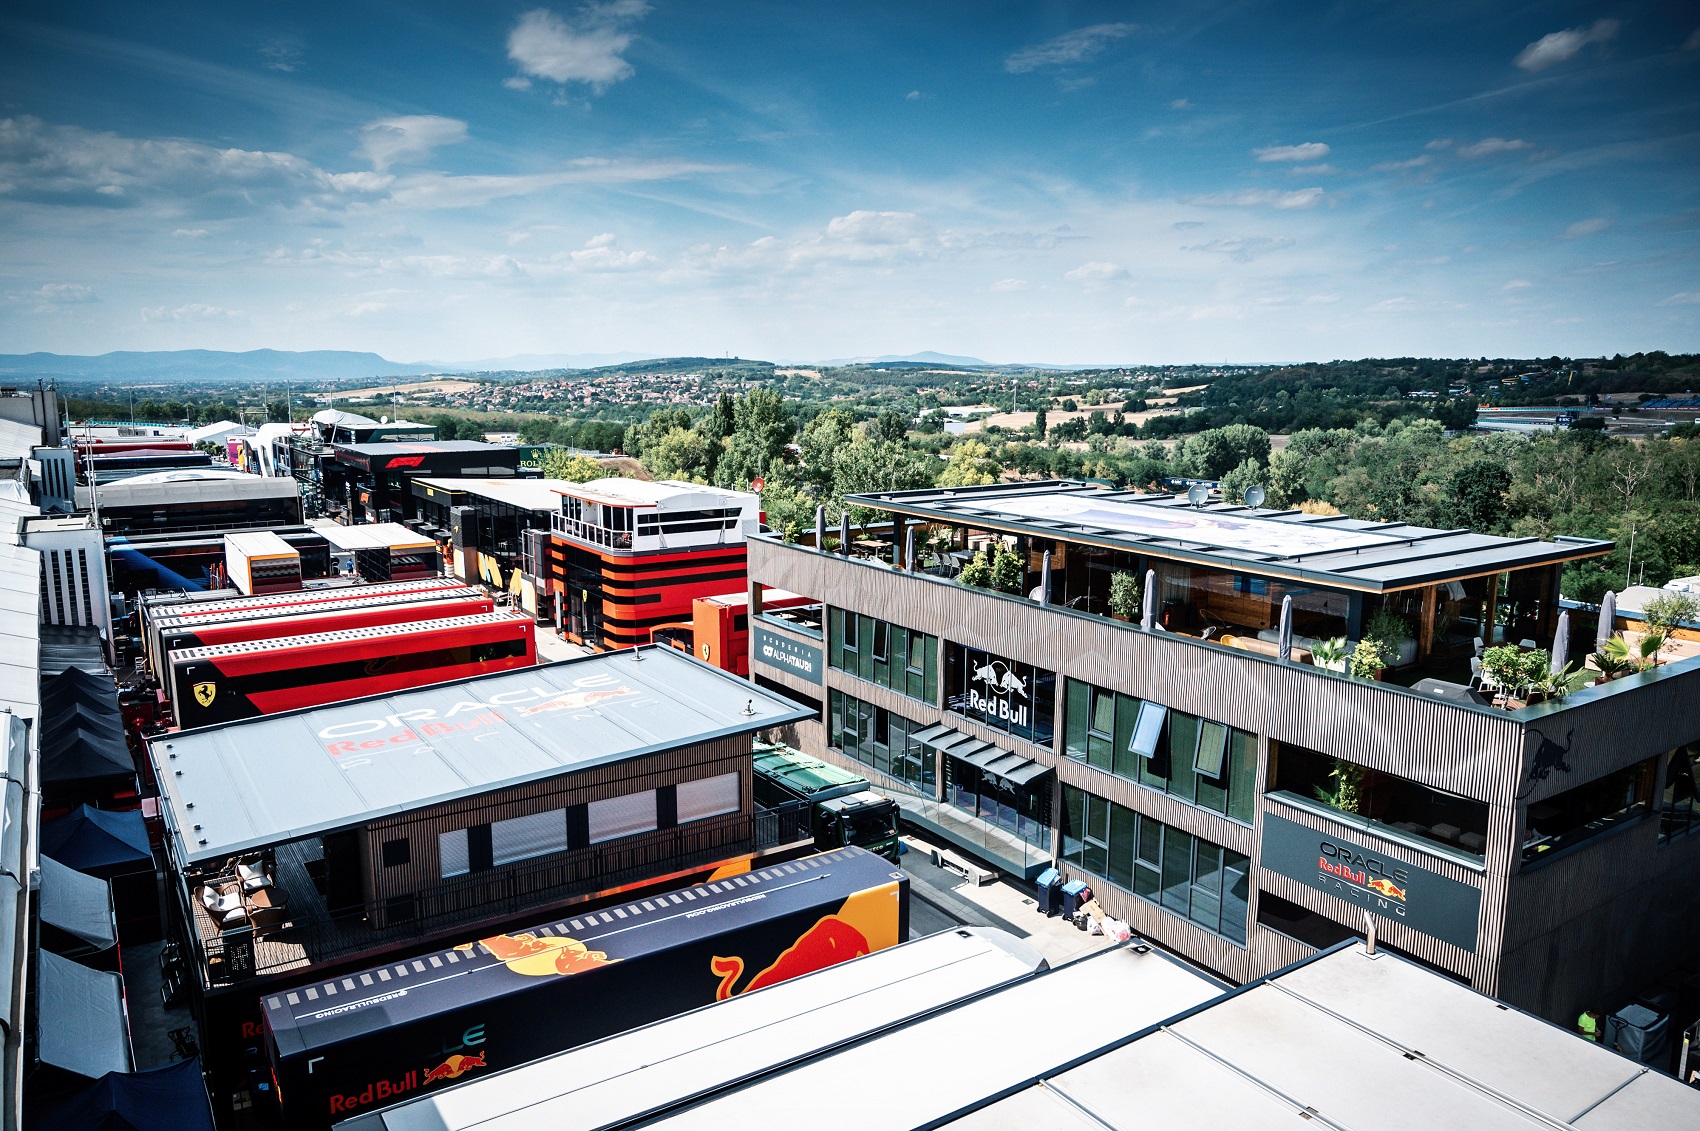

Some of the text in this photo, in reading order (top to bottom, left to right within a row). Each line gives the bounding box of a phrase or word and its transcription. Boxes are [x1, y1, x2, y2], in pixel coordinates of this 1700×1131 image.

[763, 634, 812, 658] SCUDERIA
[773, 648, 812, 673] ALPHATAURI
[318, 673, 620, 739] ORACLE
[970, 688, 997, 716] Red
[999, 698, 1027, 727] Bull
[326, 711, 507, 756] Red Bull
[1318, 856, 1365, 886] Red Bull
[1320, 841, 1408, 885] ORACLE
[1318, 874, 1406, 917] RACING
[241, 1021, 264, 1038] Re
[330, 1070, 417, 1114] Red Bull
